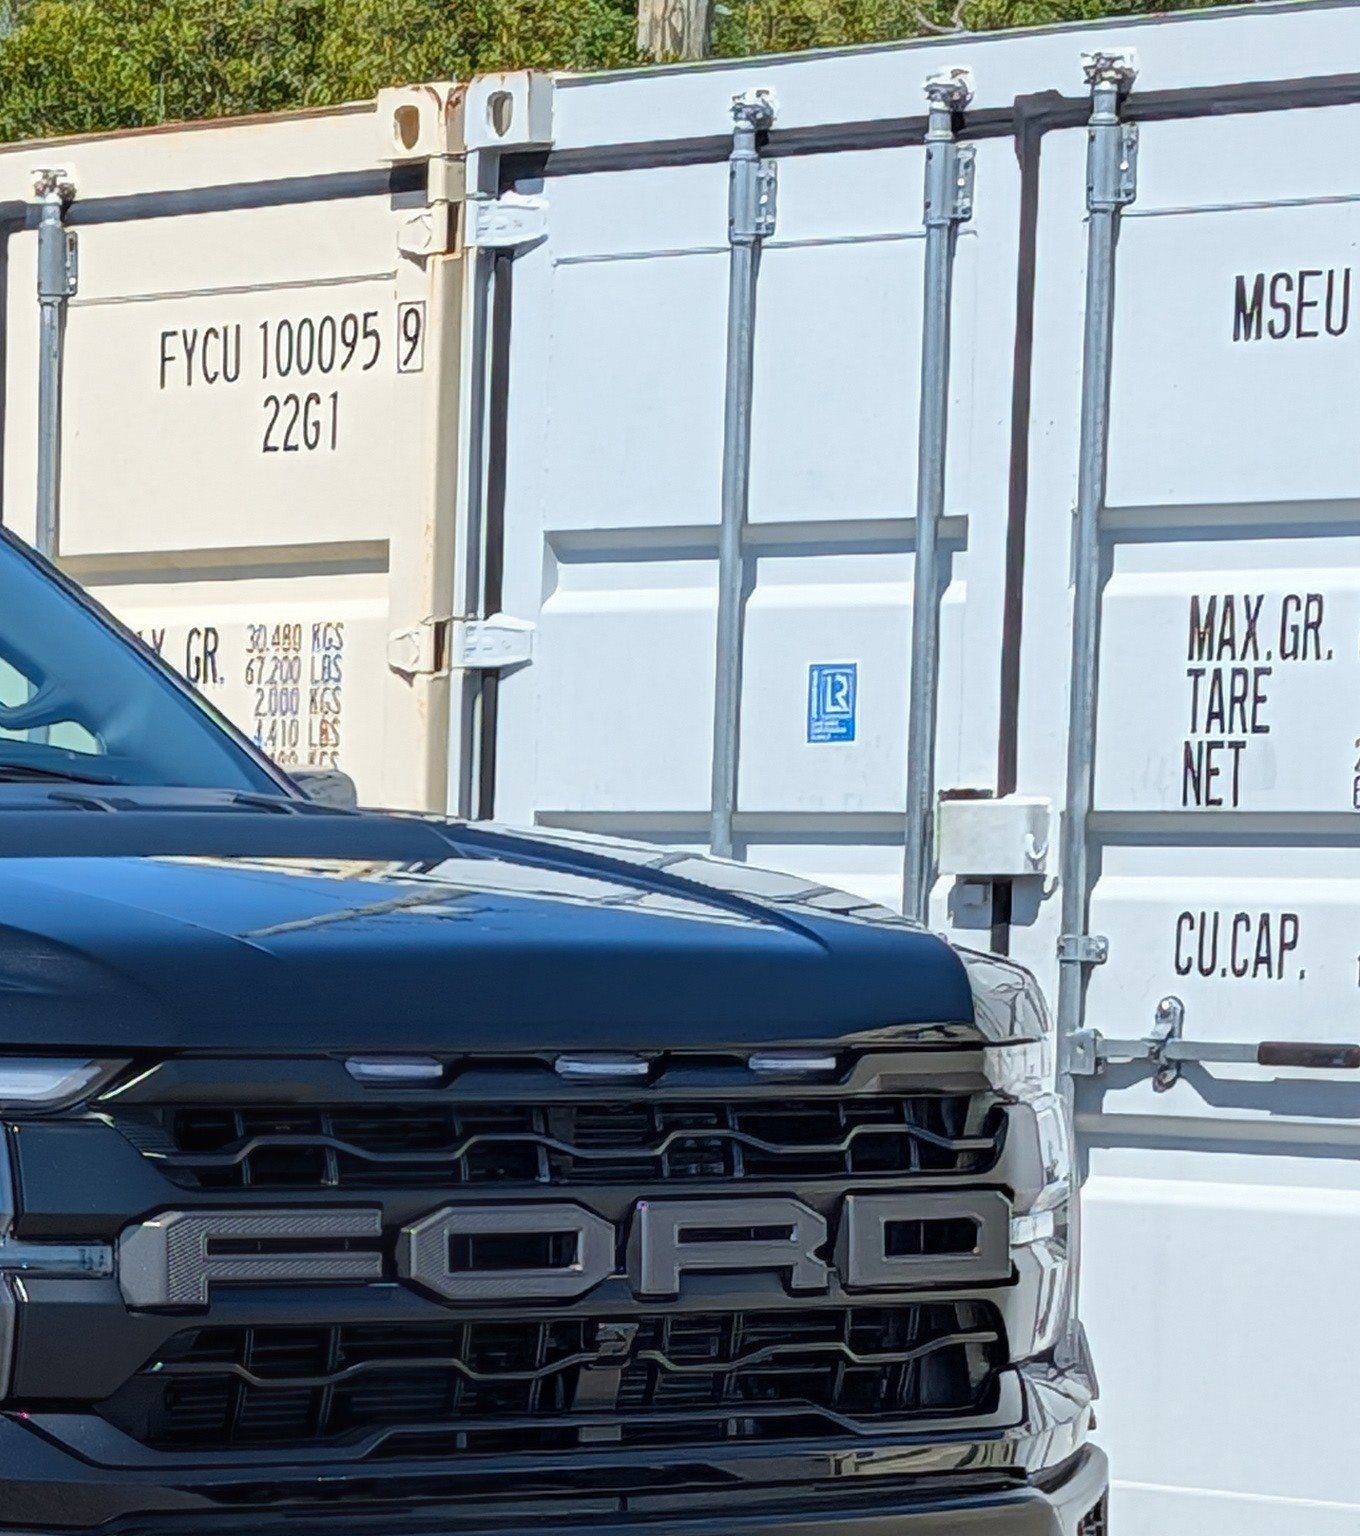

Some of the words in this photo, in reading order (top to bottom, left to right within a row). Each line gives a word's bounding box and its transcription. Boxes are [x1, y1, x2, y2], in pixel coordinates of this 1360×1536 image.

[1233, 268, 1351, 341] MSEU
[160, 323, 241, 390] FYCU
[258, 311, 382, 379] 100095
[401, 307, 422, 367] 9
[262, 390, 340, 453] 22G1
[186, 627, 224, 684] GR.
[311, 621, 344, 651] KGS
[1187, 593, 1333, 663] MAX.GR.
[309, 686, 341, 715] KGS
[310, 654, 342, 684] LBS
[1187, 666, 1271, 736] TARE
[308, 717, 340, 748] LBS
[1182, 740, 1247, 808] NET
[1174, 912, 1307, 981] CU.CAP.
[119, 1193, 1014, 1314] FORD
